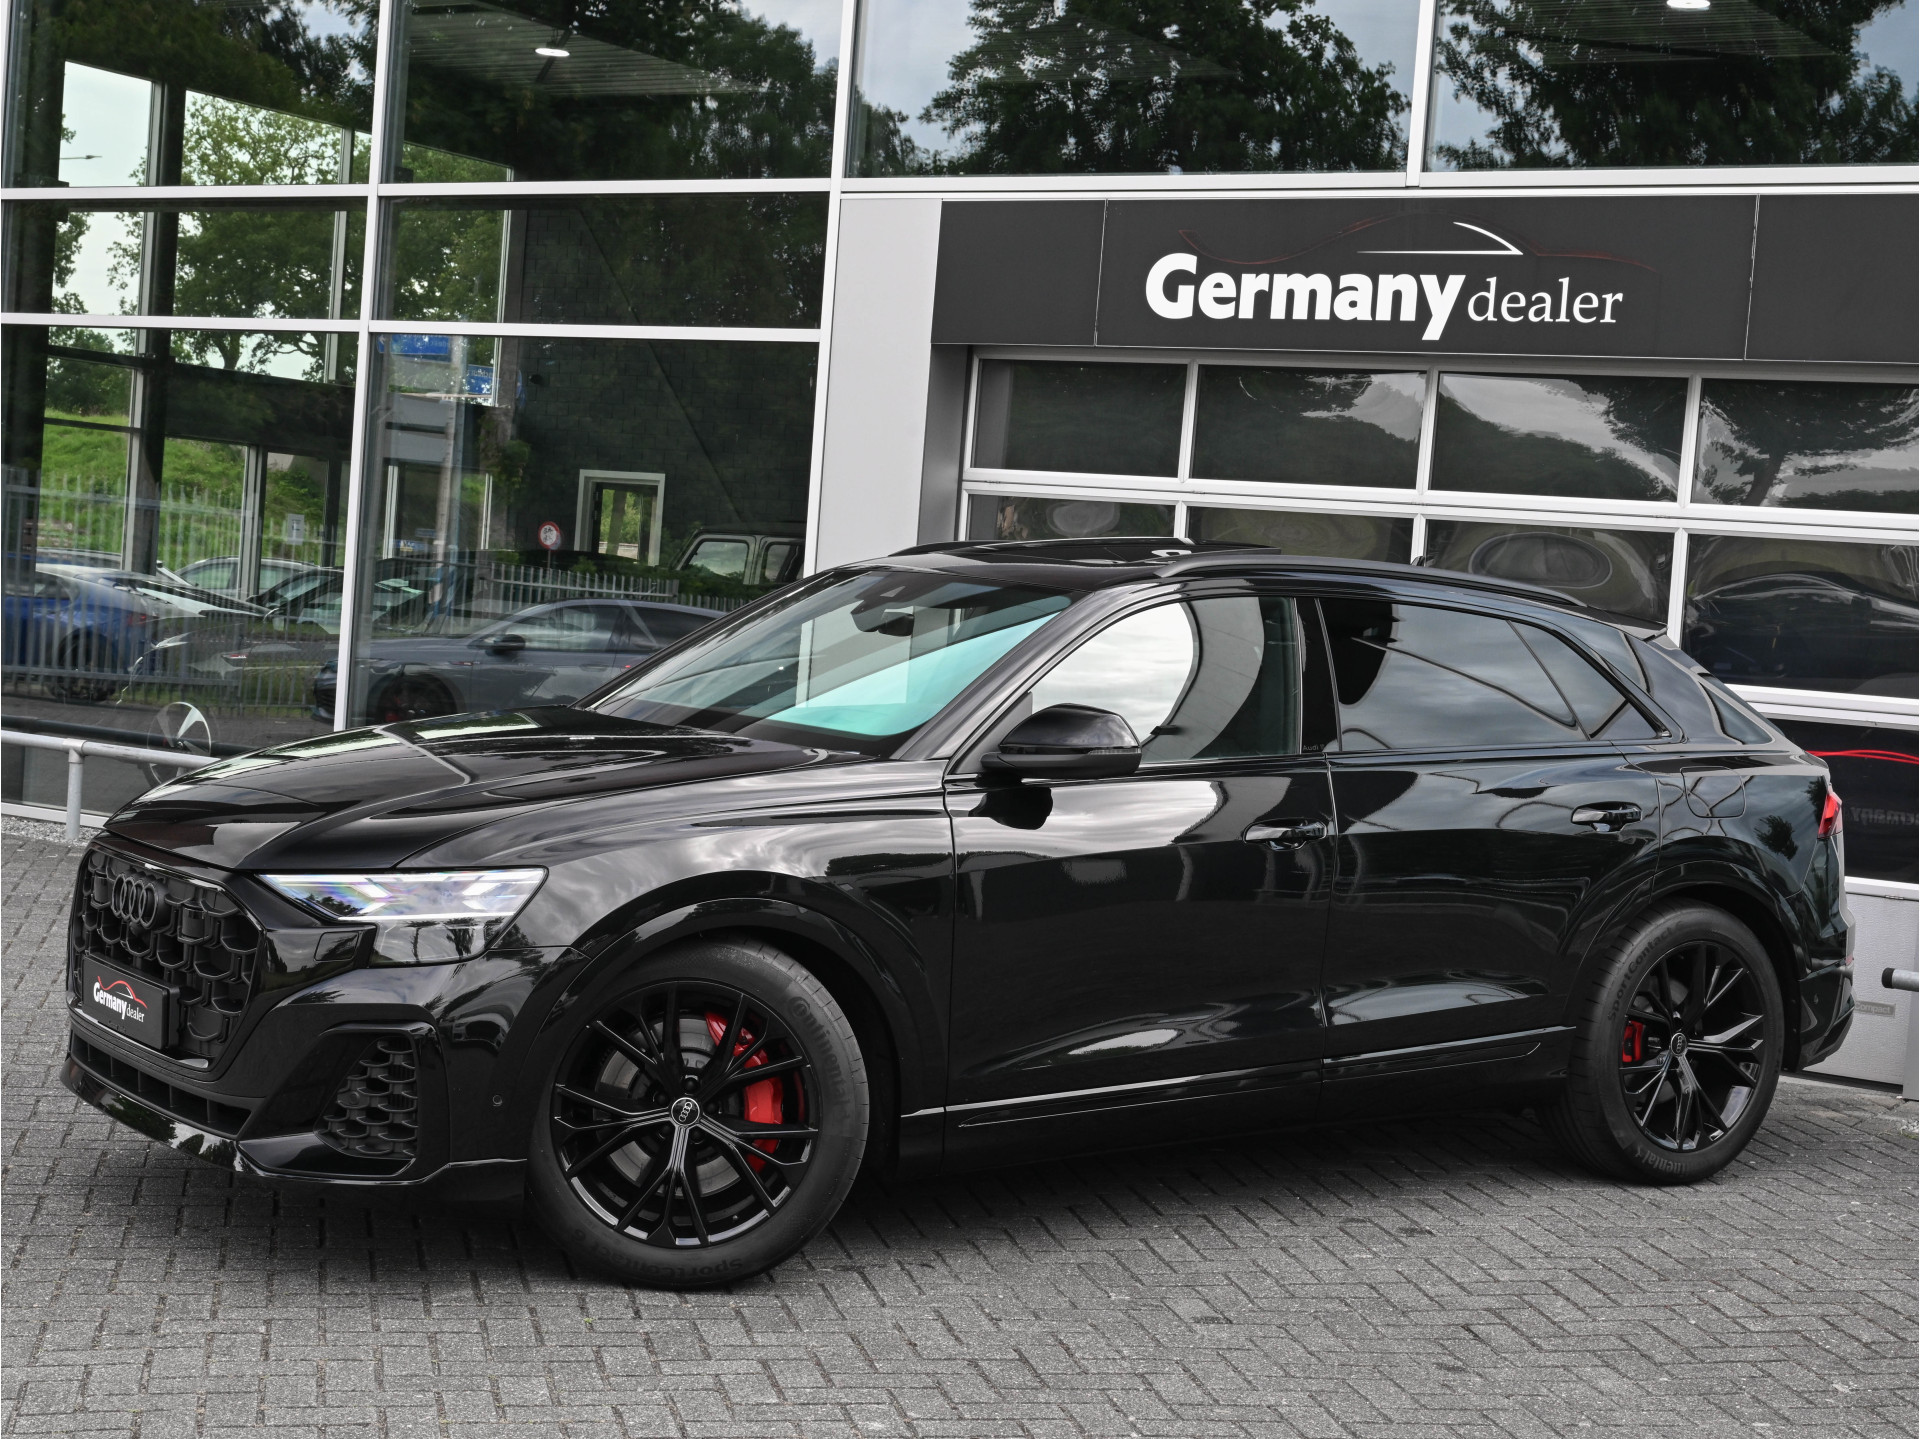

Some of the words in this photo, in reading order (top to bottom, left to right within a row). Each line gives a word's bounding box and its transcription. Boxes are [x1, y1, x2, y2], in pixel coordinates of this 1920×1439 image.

[1146, 253, 1467, 340] Germany
[1467, 277, 1625, 324] dealer
[93, 982, 127, 1020] Germany
[126, 1004, 145, 1022] dealer
